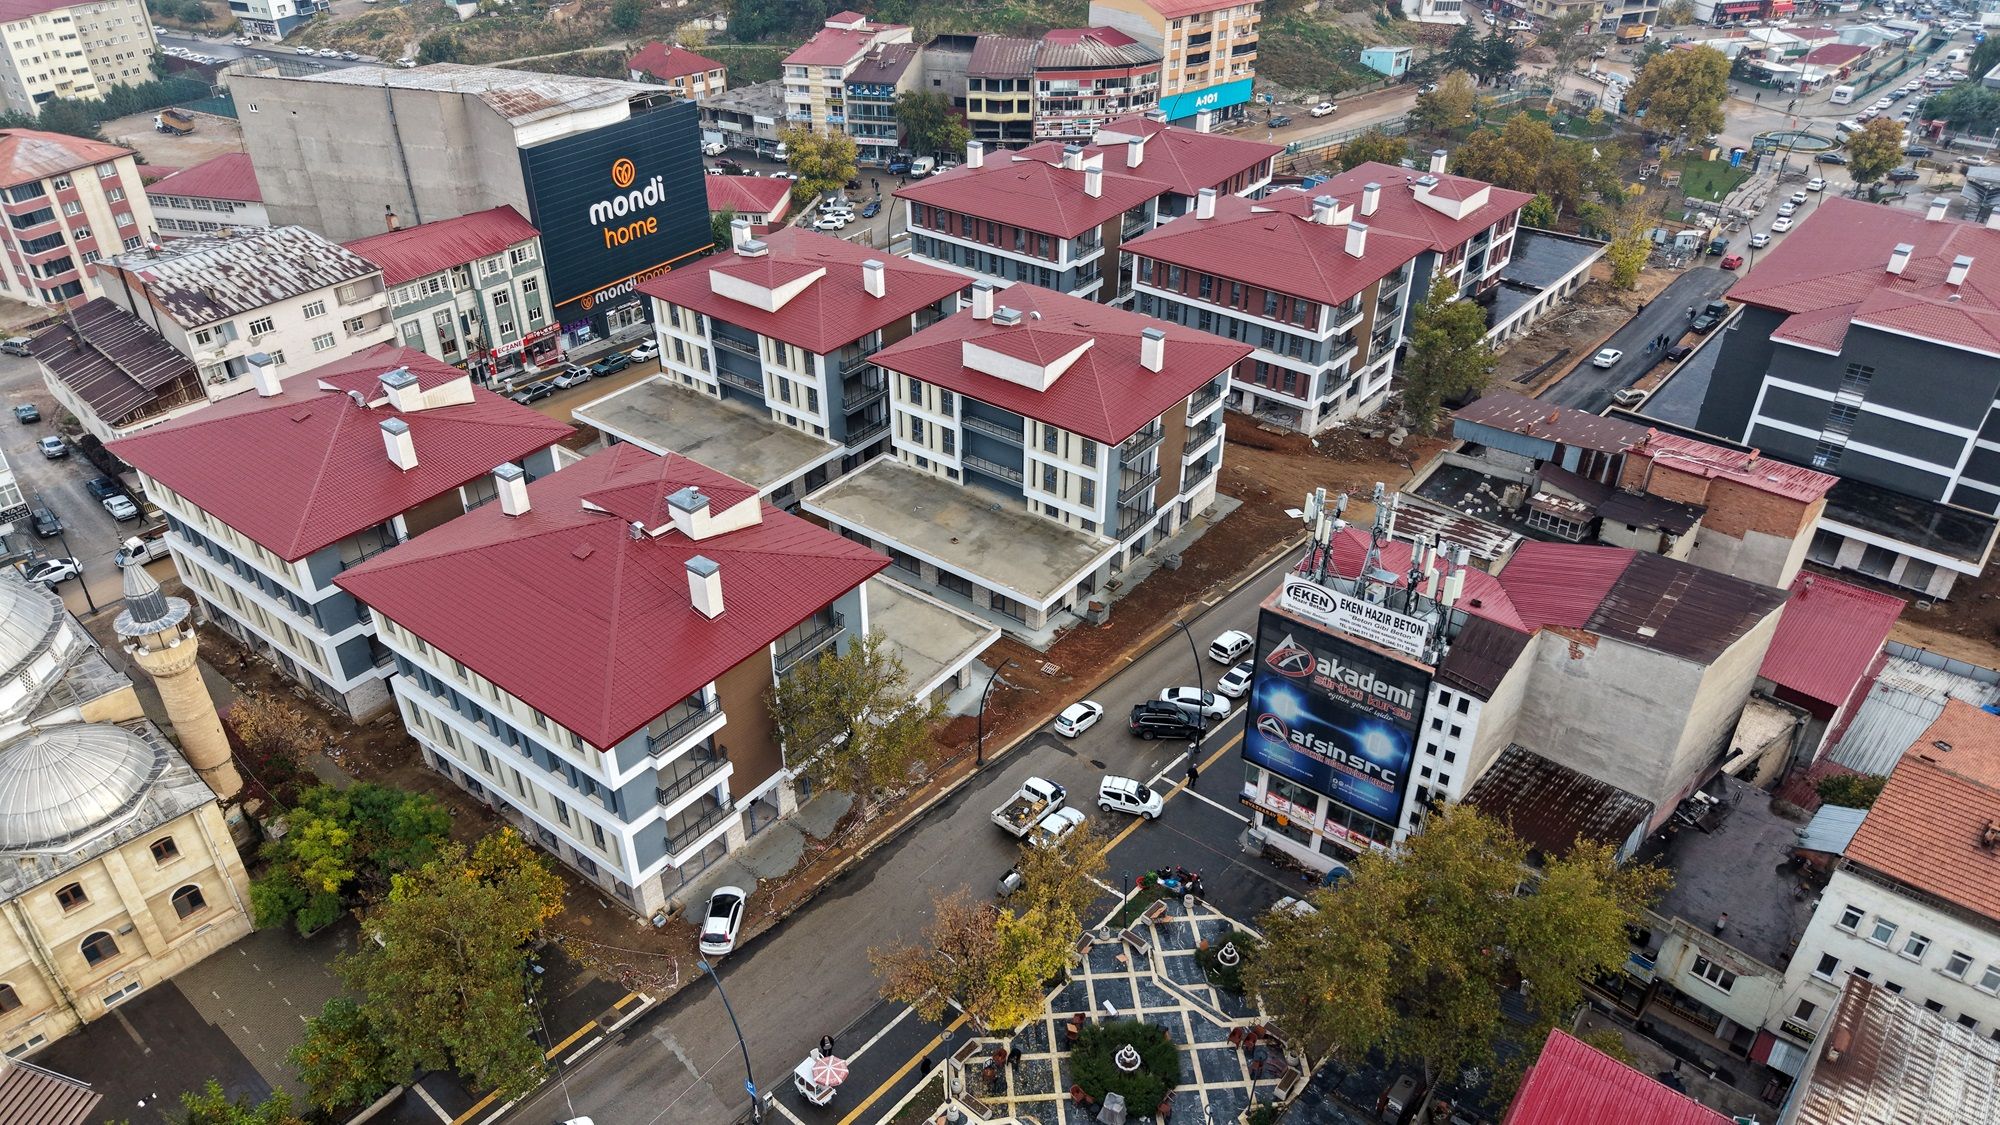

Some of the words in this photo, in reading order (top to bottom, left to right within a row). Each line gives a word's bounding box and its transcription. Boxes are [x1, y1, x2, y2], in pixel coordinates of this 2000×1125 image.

[589, 175, 666, 226] mondi
[603, 216, 658, 249] home
[595, 277, 637, 305] mondi
[497, 340, 522, 353] ECZANE
[1292, 586, 1329, 608] EKEN
[1339, 598, 1364, 616] EKEN
[1365, 607, 1392, 625] HAZIR
[1393, 618, 1425, 637] BETON
[1314, 674, 1364, 702] sürücü
[1367, 693, 1411, 721] kursu
[1316, 657, 1416, 709] akademi
[1290, 729, 1347, 763] afşin
[1348, 754, 1396, 784] src
